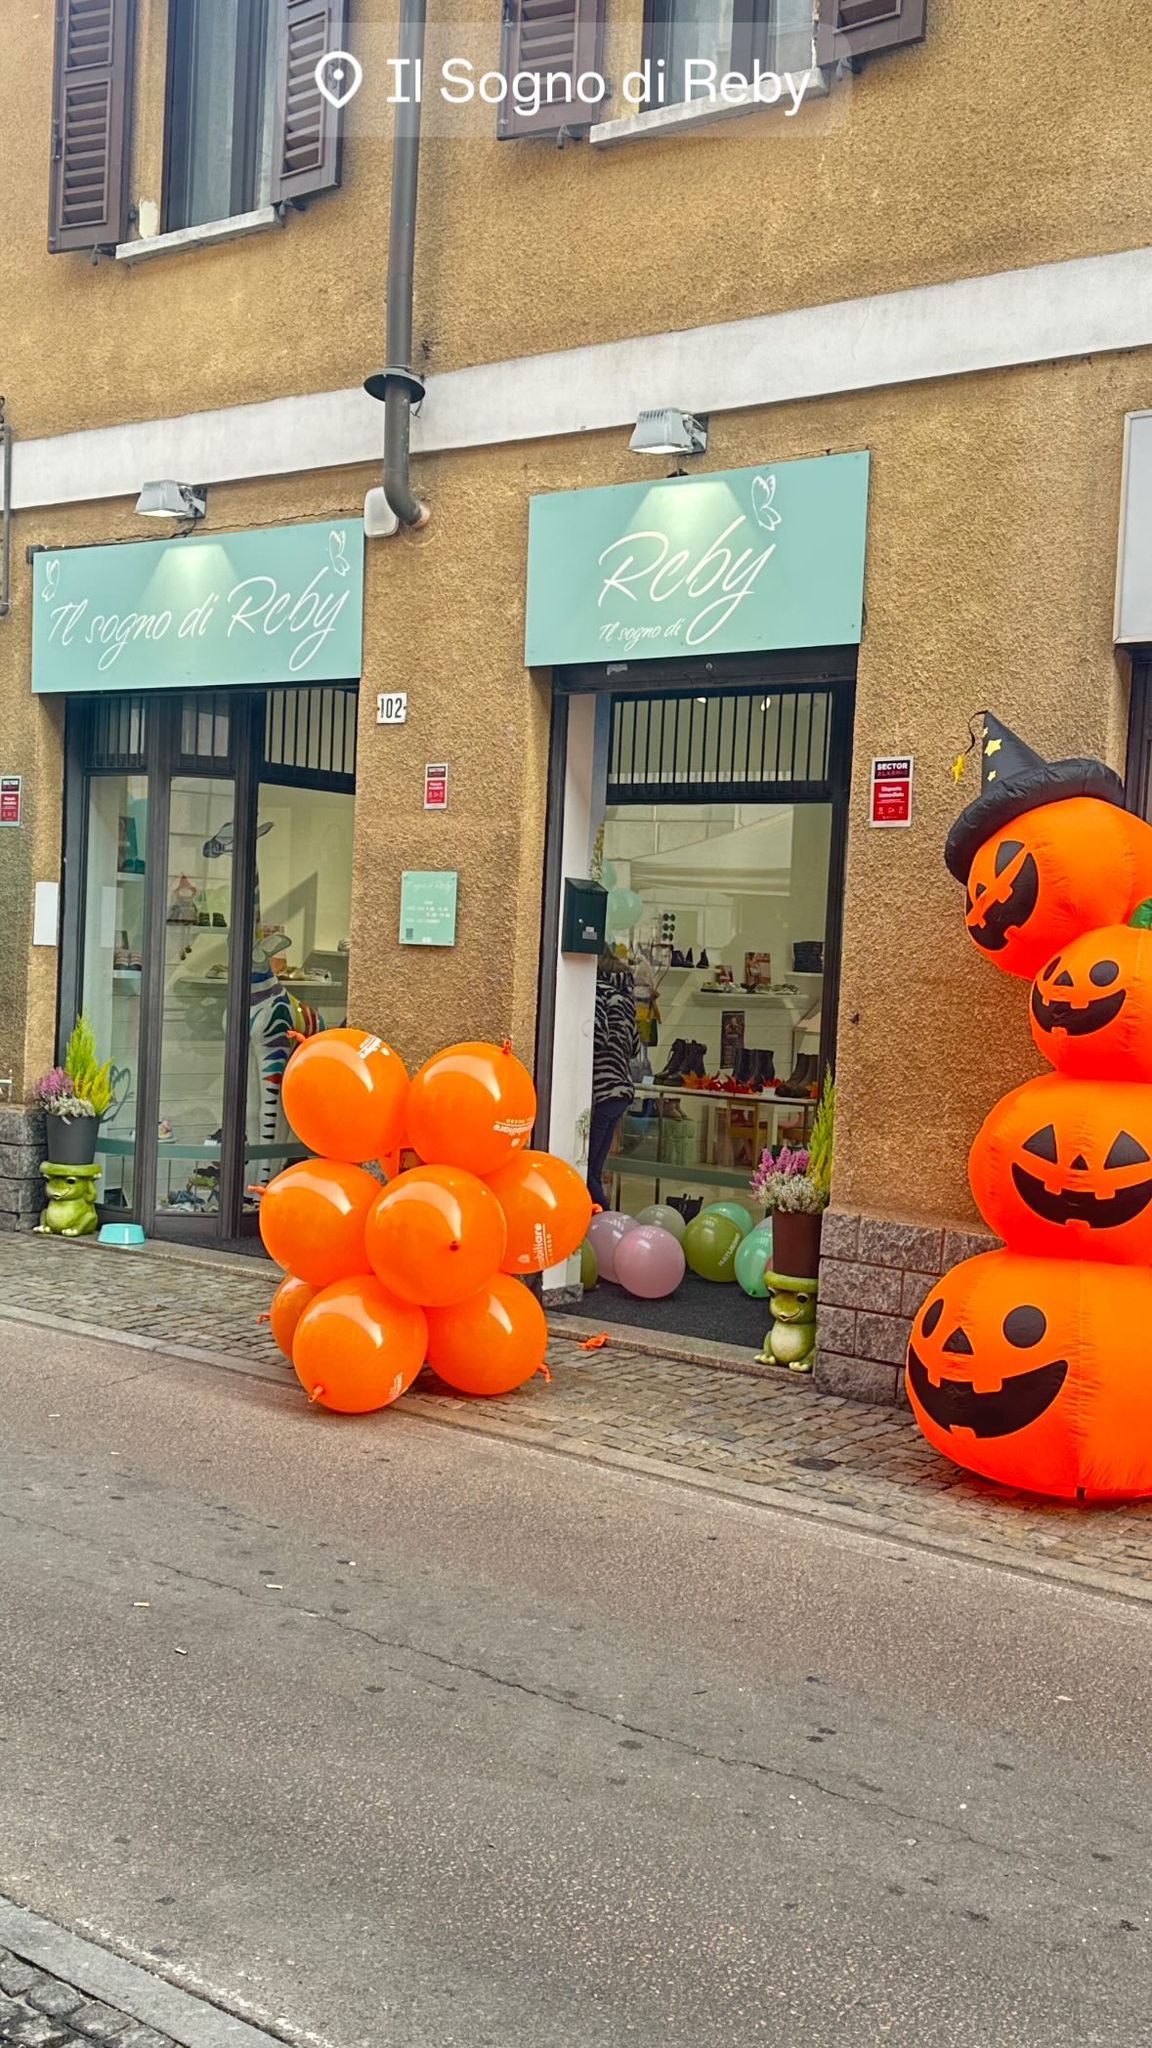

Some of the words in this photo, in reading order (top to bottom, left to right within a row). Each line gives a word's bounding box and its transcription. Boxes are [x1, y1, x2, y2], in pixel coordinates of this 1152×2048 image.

[598, 515, 776, 646] Reby
[48, 598, 88, 646] Il
[85, 610, 173, 671] sogno
[177, 592, 219, 639] di
[227, 565, 350, 671] Reby
[618, 625, 662, 652] sogno
[663, 617, 686, 638] di
[381, 698, 402, 718] 102
[877, 762, 908, 771] SECTOR
